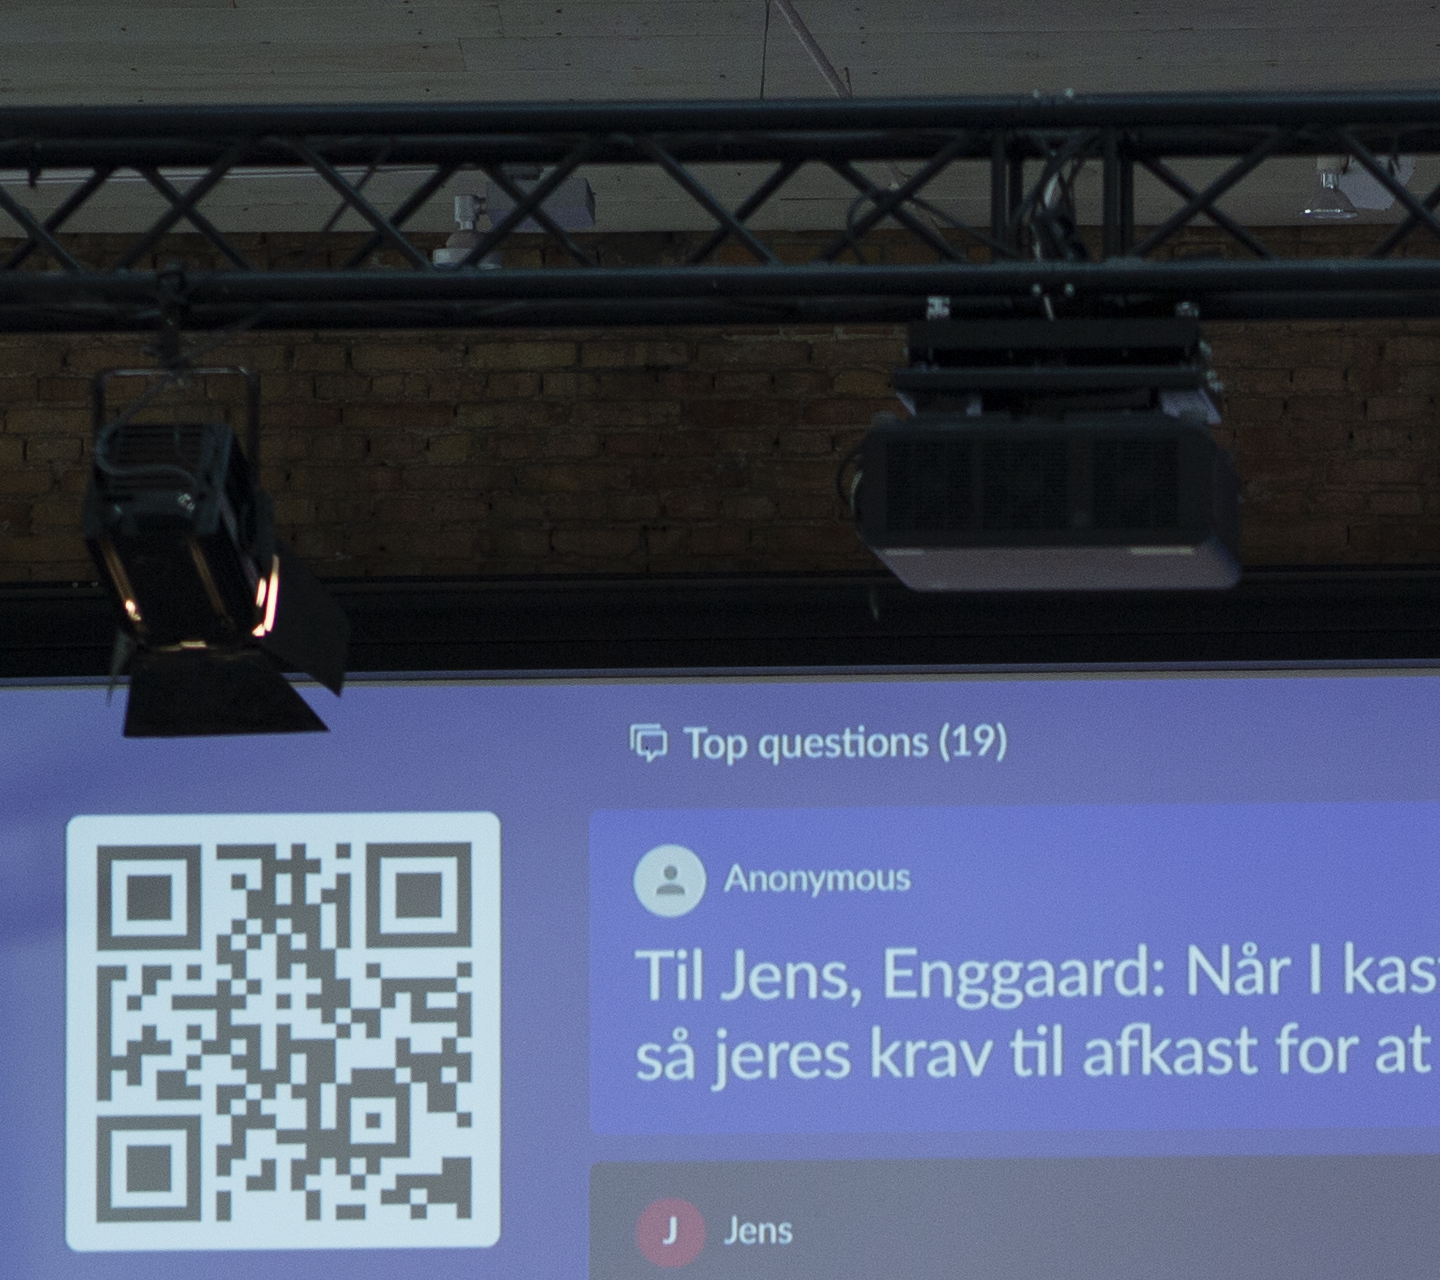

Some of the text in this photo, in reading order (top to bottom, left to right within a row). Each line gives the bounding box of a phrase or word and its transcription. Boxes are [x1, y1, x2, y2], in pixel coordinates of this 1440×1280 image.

[682, 721, 1008, 767] Top questions (19)
[723, 862, 912, 899] Anonymous
[634, 947, 703, 1002] Til
[719, 948, 862, 1008] Jens,
[884, 942, 1165, 1011] Enggaard:
[1187, 941, 1293, 997] Når
[1310, 942, 1322, 995] I
[636, 1026, 695, 1082] så
[710, 1027, 852, 1093] jeres
[871, 1024, 994, 1079] krav
[1009, 1023, 1063, 1078] til
[1082, 1021, 1259, 1078] afkast
[1274, 1021, 1361, 1075] for
[1375, 1024, 1432, 1075] at
[723, 1215, 794, 1245] Jens
